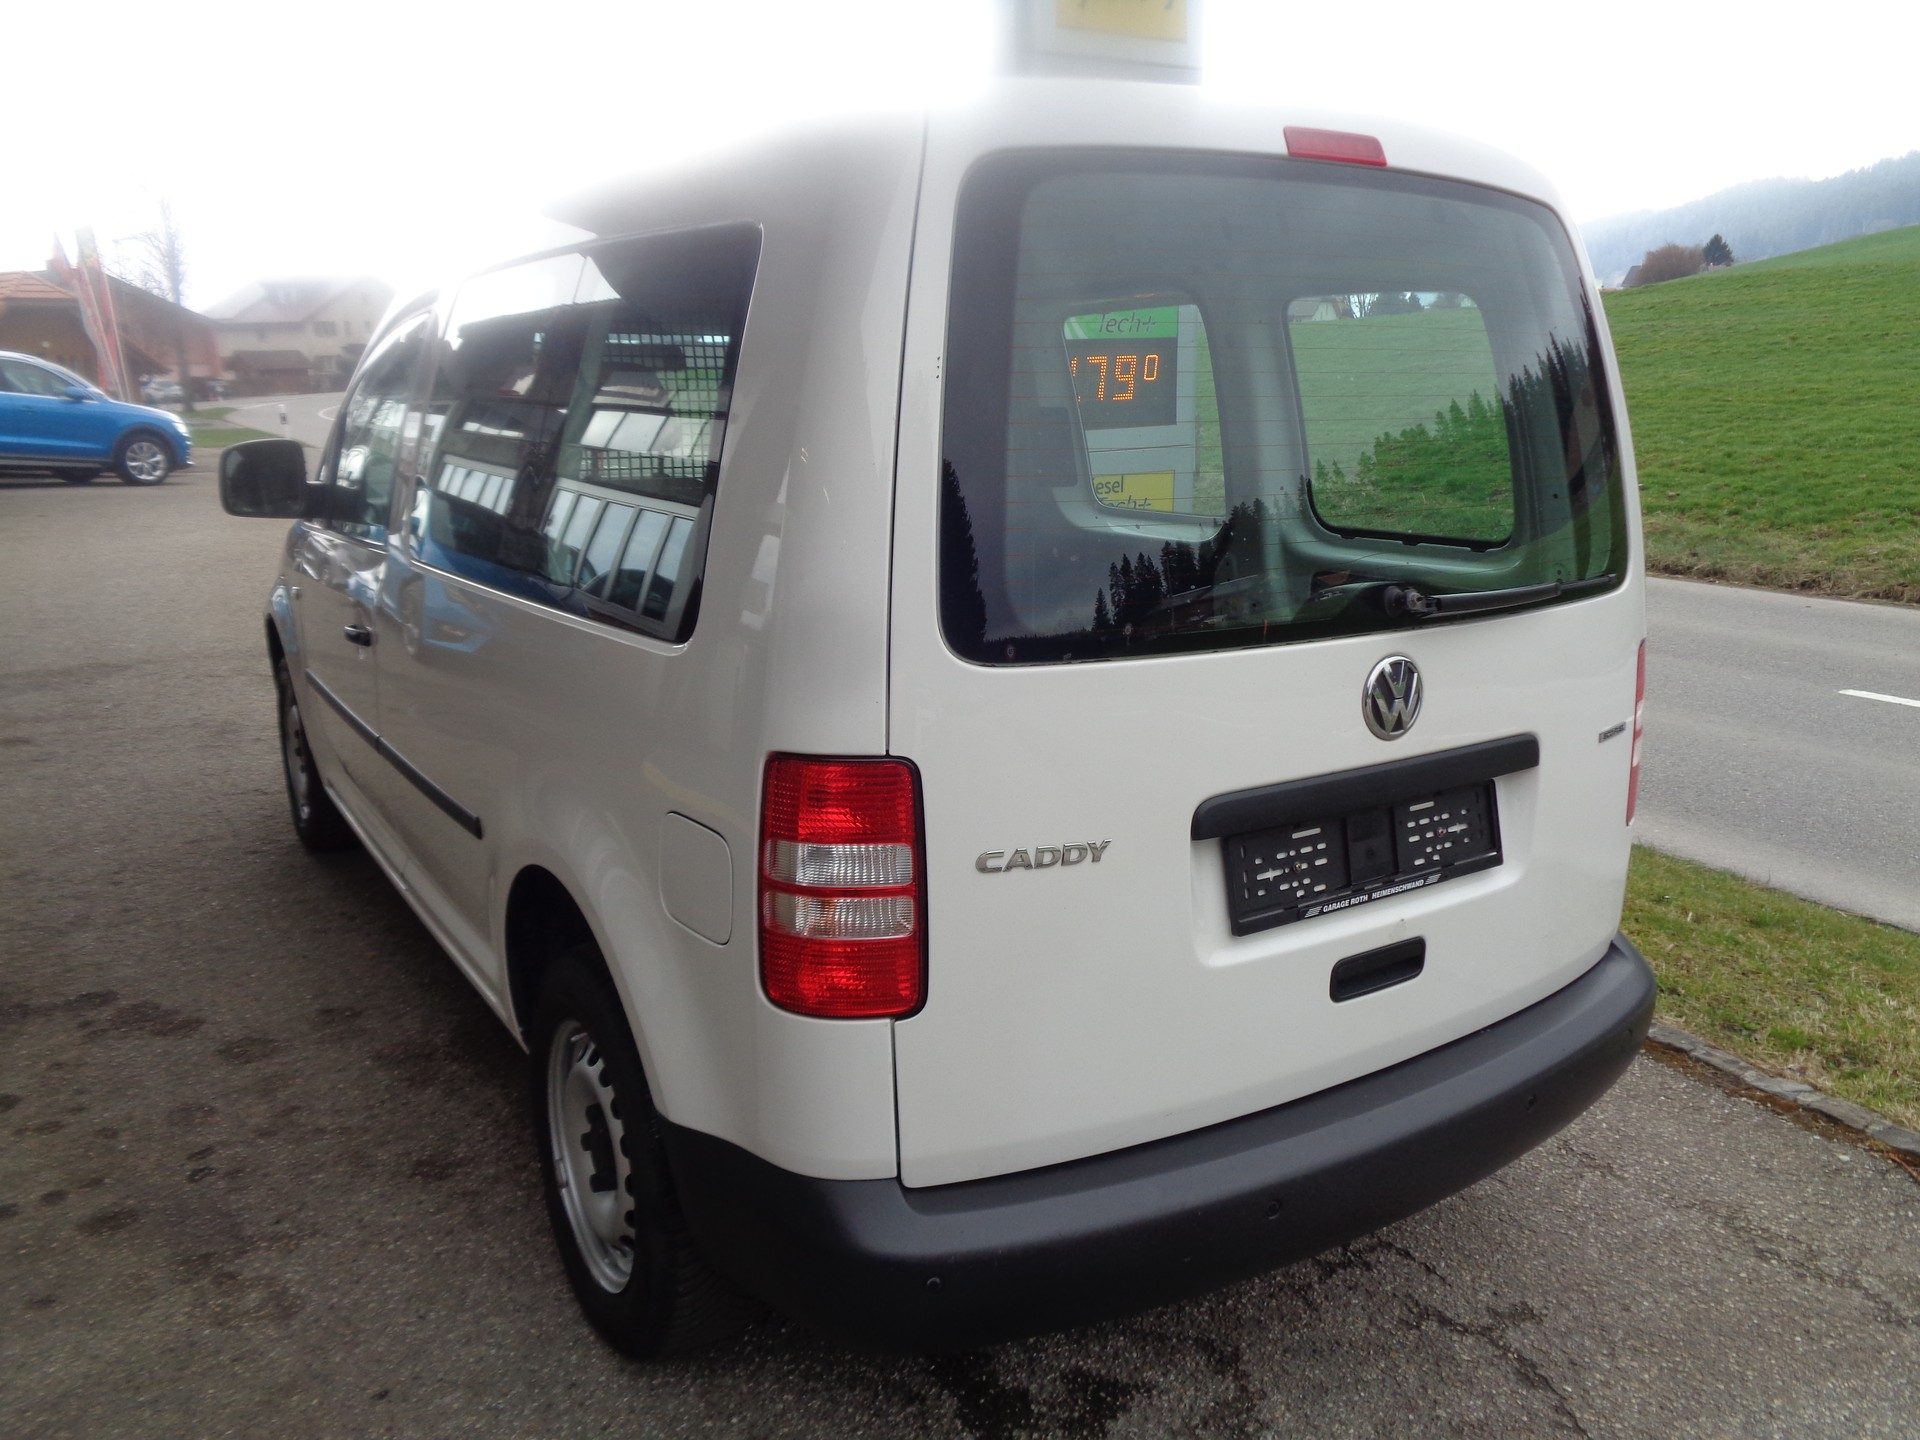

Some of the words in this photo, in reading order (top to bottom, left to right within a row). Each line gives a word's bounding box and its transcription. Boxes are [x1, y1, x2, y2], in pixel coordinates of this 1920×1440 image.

[975, 838, 1113, 873] CADDY
[1323, 899, 1350, 913] GARAGE
[1350, 894, 1369, 906] ROTH
[1371, 879, 1424, 900] HEIMENSCHWAND
